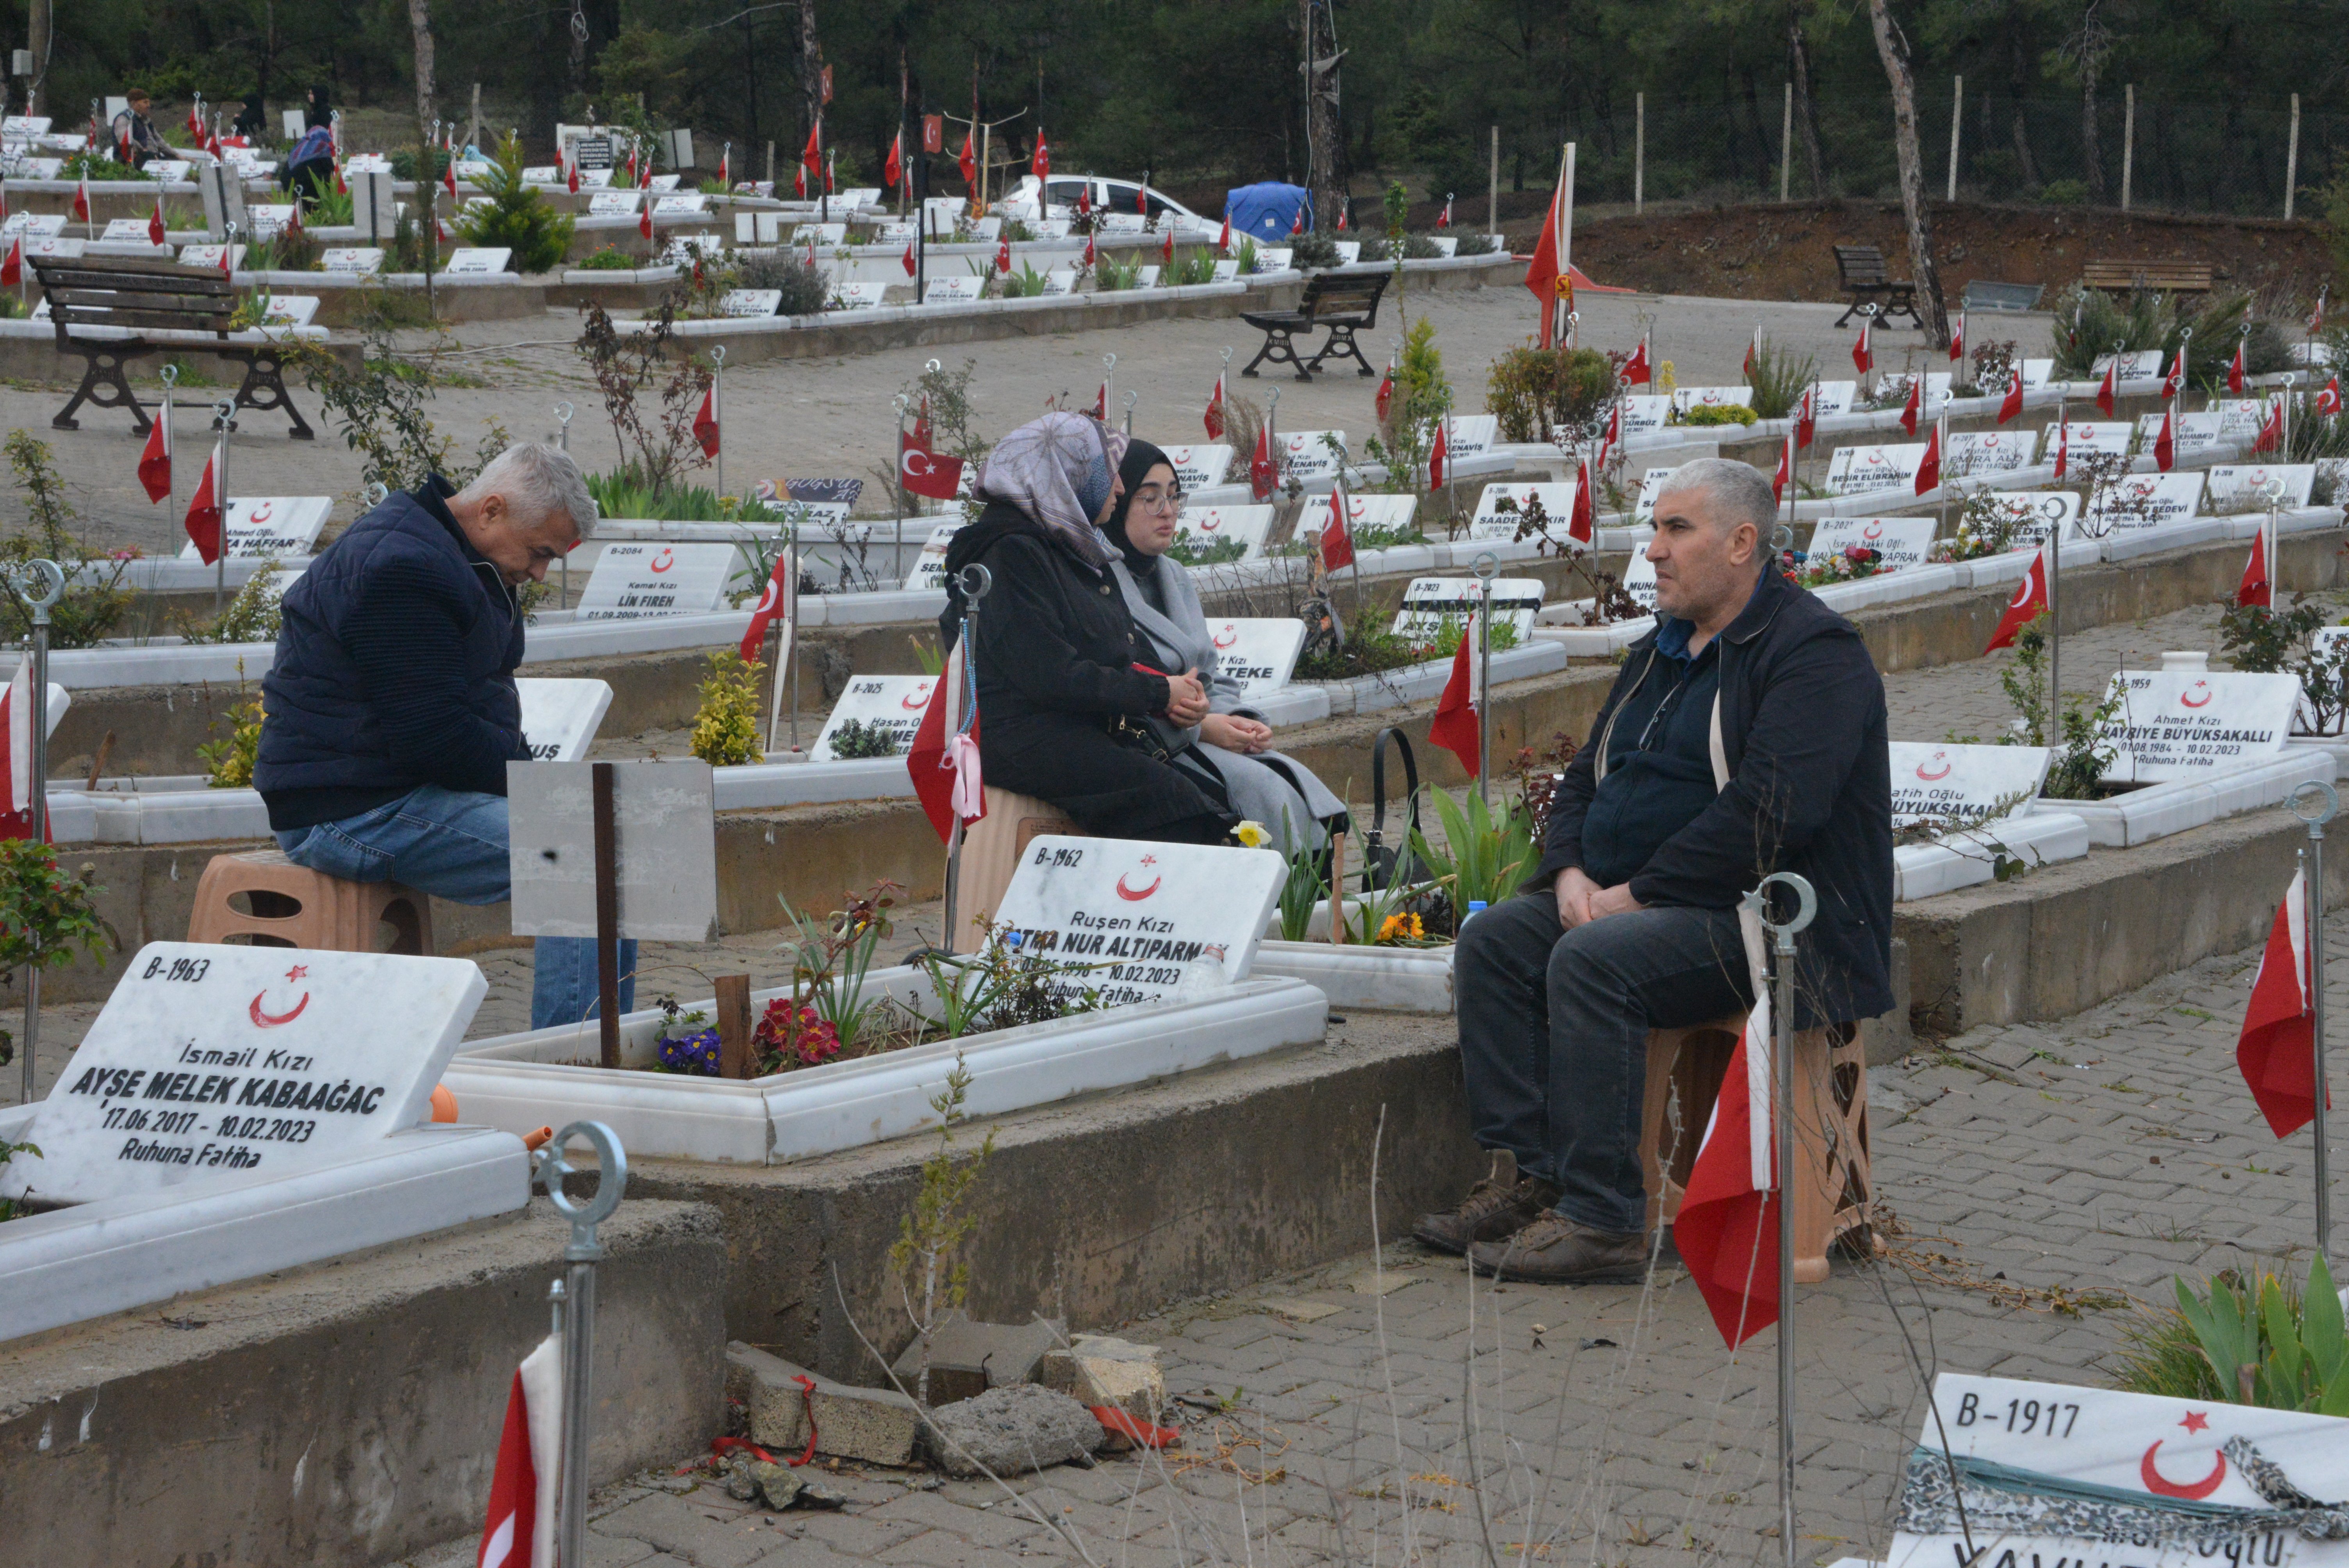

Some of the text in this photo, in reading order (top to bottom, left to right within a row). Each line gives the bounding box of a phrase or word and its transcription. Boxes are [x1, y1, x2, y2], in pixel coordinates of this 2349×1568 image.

[1178, 474, 1210, 483] NAVİŞ
[1228, 656, 1247, 665] Kızı
[1225, 667, 1274, 679] TEKE
[852, 683, 884, 694] B-2025
[871, 717, 907, 727] Hasan
[2154, 715, 2221, 726] Ahmet Kızı
[2187, 744, 2240, 755] 10.02.2023
[2138, 754, 2214, 766] Ruhuna Fatiha
[1892, 788, 1965, 802] atih Oğlu
[1035, 846, 1083, 868] B-1962
[1070, 910, 1174, 934] Ruşen Kızı
[1061, 932, 1106, 955] NUR
[142, 956, 211, 983] B-1963
[1108, 964, 1182, 985] 10.02.2023
[1097, 985, 1144, 1004] Fatiha
[178, 1037, 314, 1071] İsmail Kızı
[141, 1070, 239, 1105] MELEK
[102, 1107, 199, 1133] 17.06.2017
[216, 1115, 316, 1143] 10.02.2023
[118, 1137, 194, 1164] Ruhuna
[1956, 1392, 2080, 1439] B-1917
